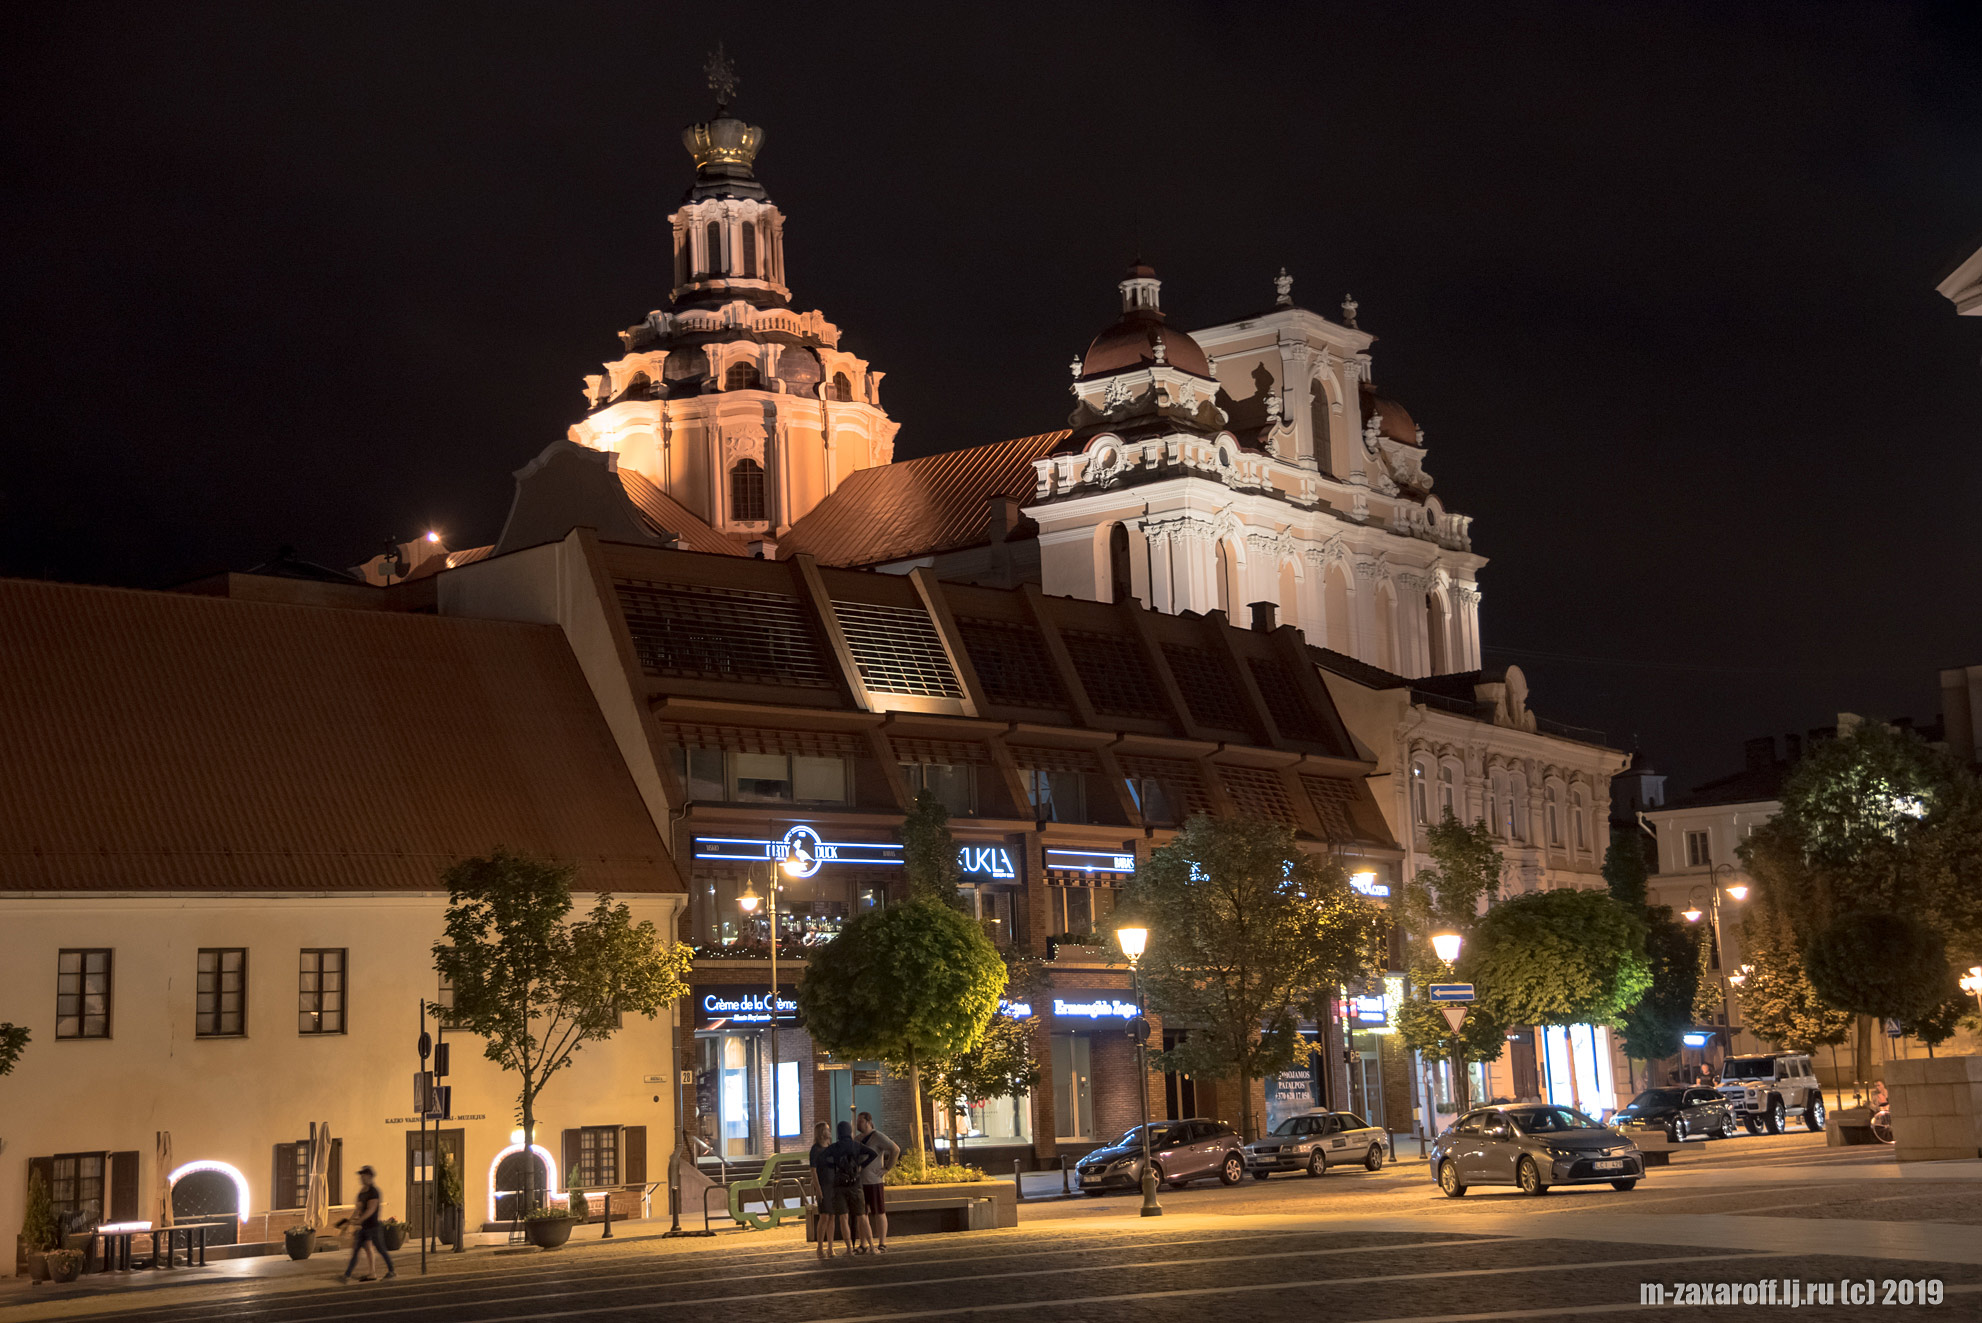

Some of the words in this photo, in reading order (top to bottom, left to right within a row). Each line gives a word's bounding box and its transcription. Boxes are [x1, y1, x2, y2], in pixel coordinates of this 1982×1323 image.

[814, 845, 838, 859] DUCK
[704, 994, 740, 1011] Crème
[740, 994, 753, 1010] de
[753, 994, 764, 1010] la
[682, 1072, 690, 1083] 28
